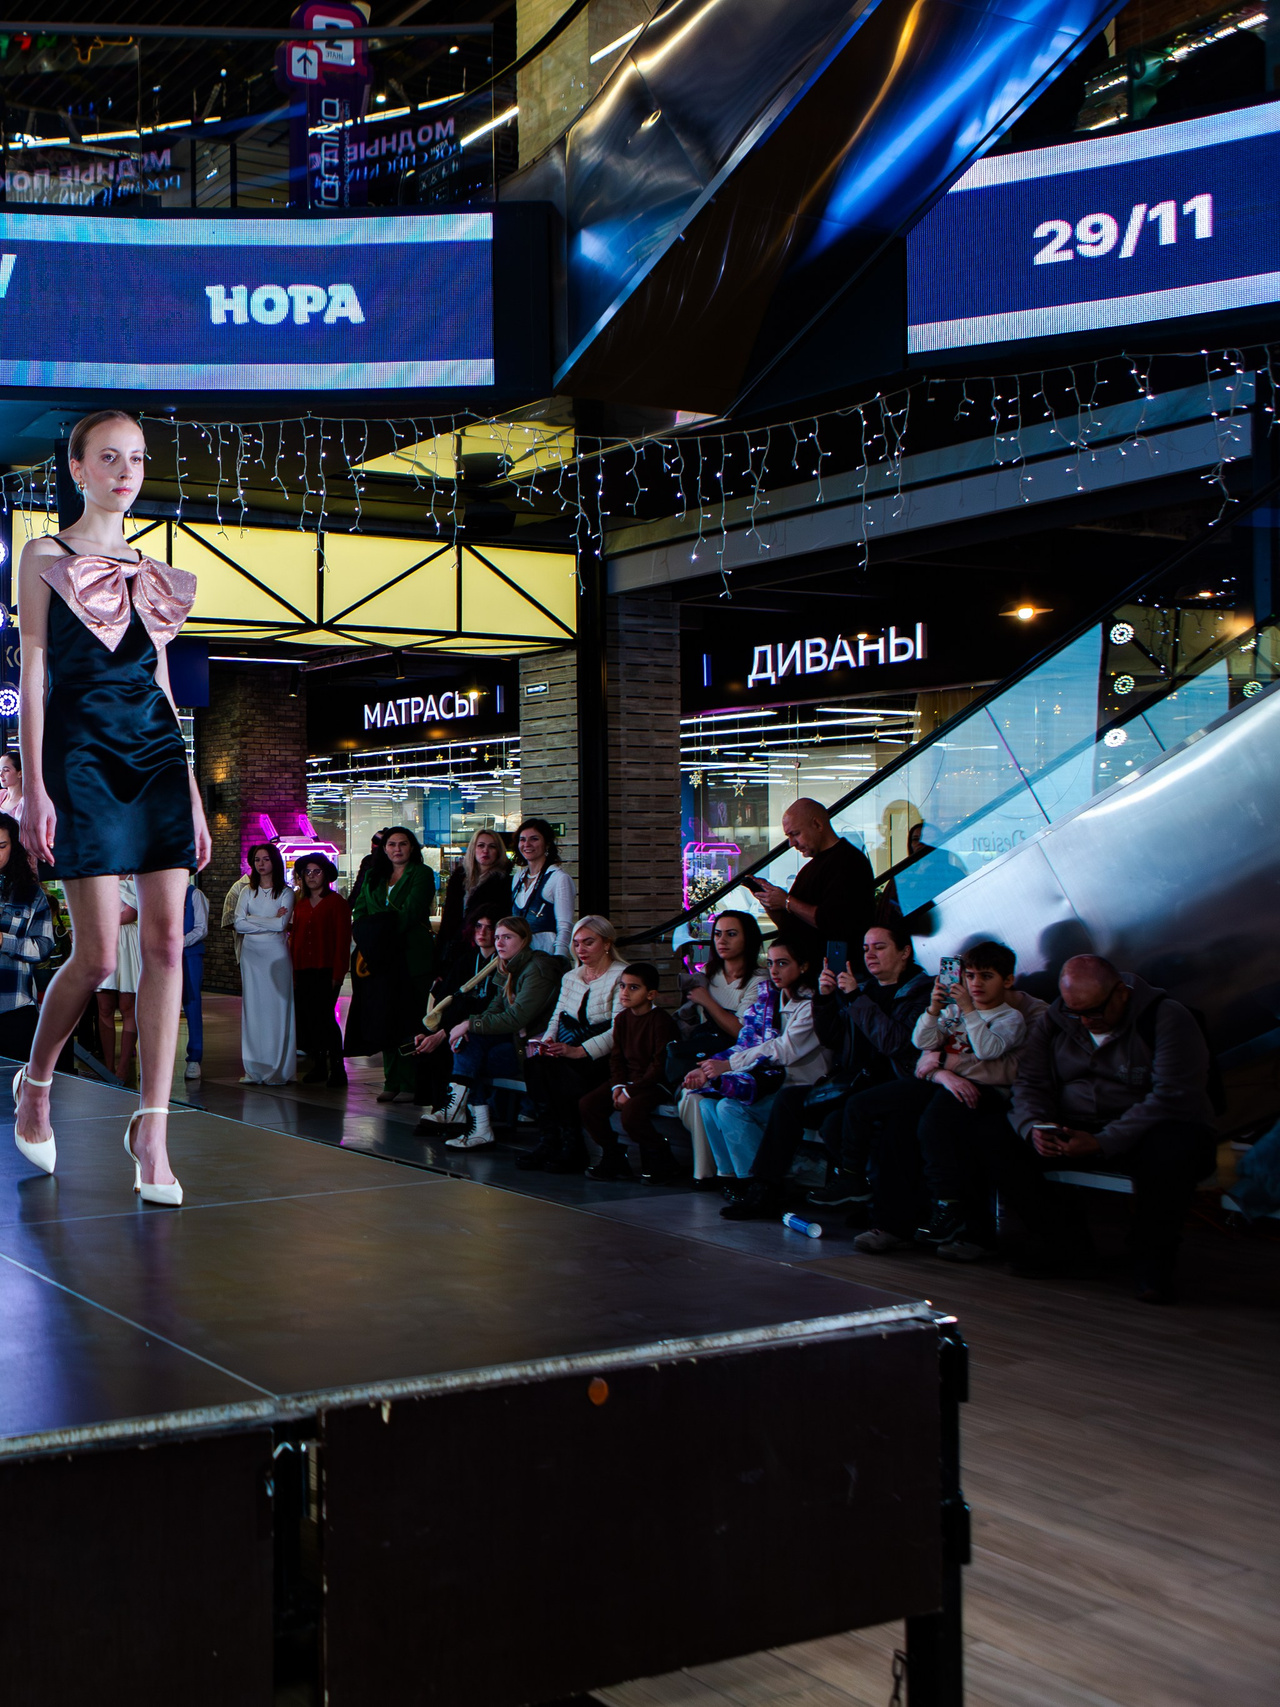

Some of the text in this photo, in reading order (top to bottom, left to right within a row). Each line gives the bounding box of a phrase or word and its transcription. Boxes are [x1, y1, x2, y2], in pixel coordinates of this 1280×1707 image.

[315, 98, 340, 208] famiia
[1033, 192, 1213, 266] 29/11
[204, 283, 366, 325] НОРА
[747, 622, 925, 688] ДИВАНЫ
[363, 690, 478, 730] МАТРАСЫ
